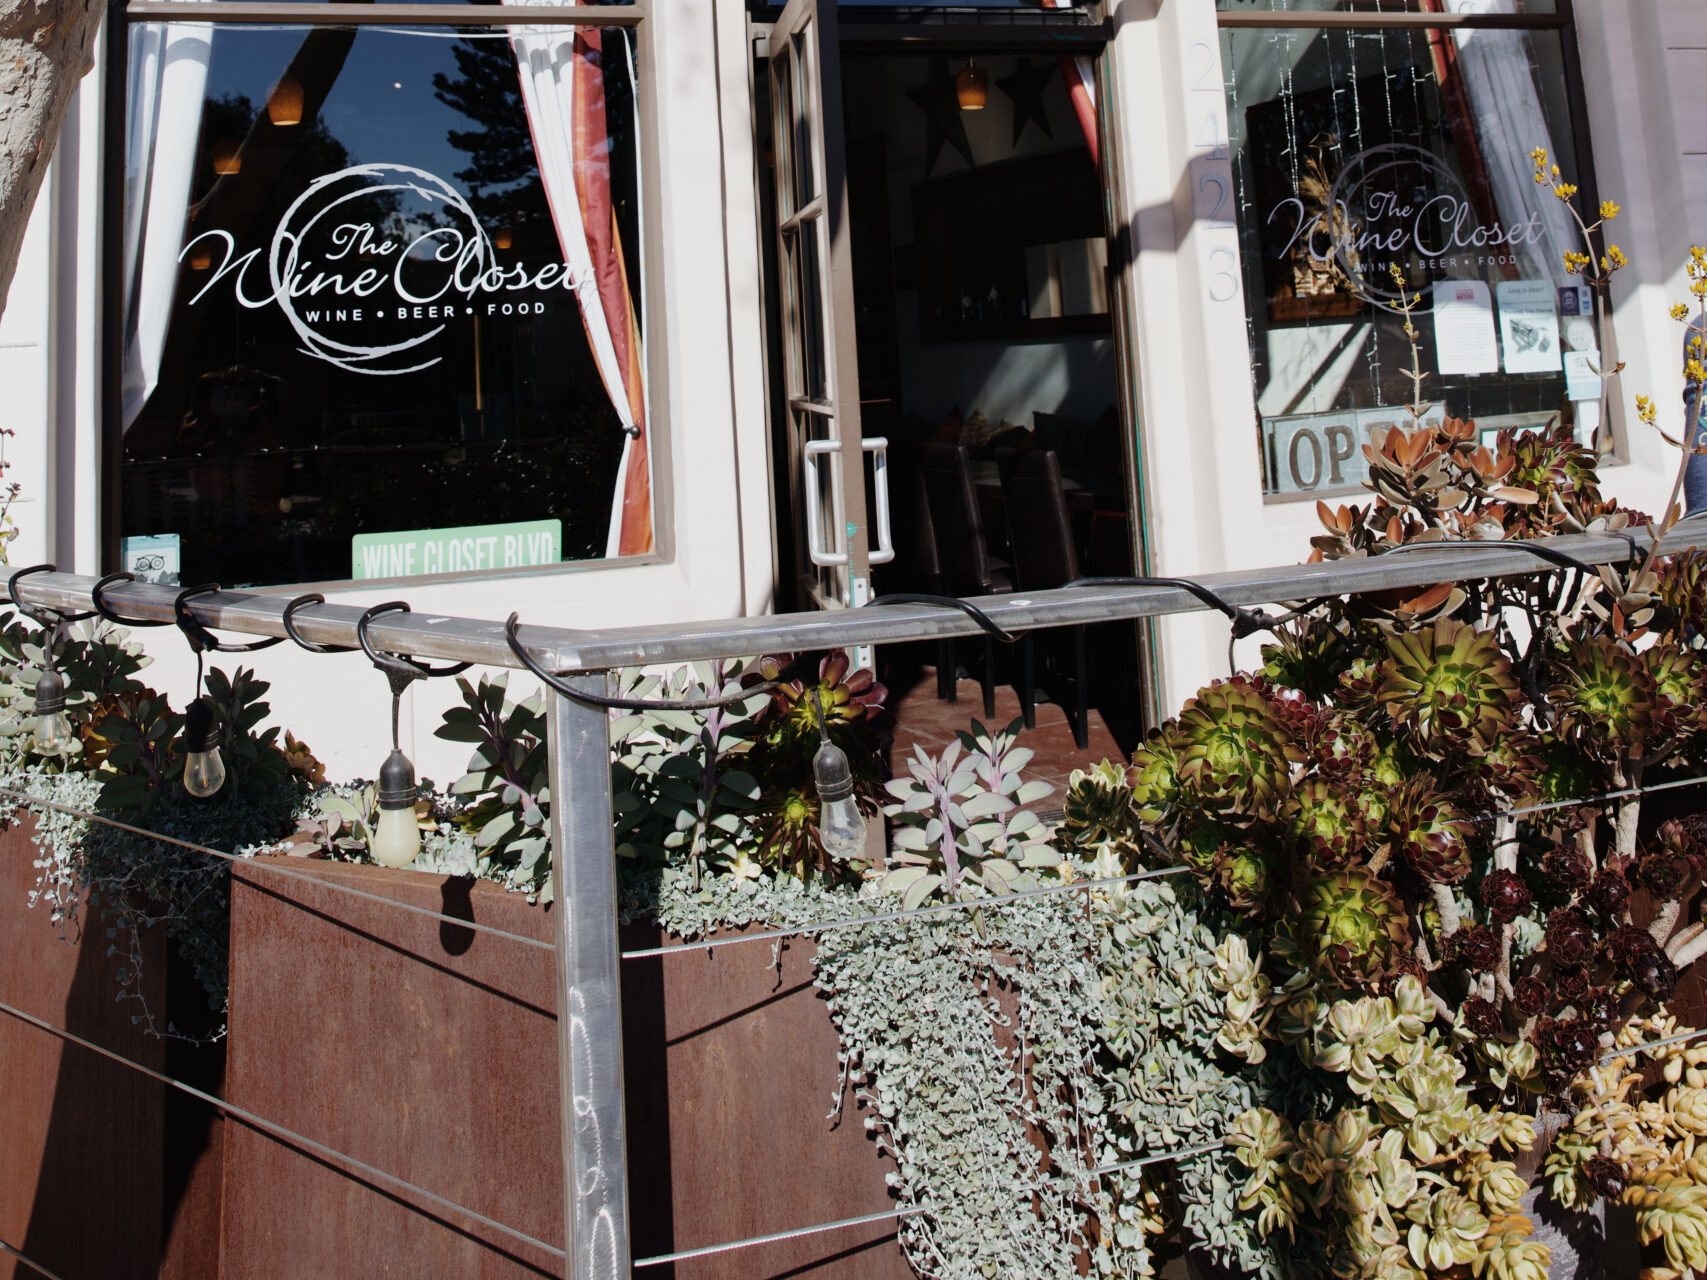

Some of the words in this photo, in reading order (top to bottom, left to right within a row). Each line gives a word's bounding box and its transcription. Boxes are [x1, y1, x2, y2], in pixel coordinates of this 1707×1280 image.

[1366, 191, 1414, 221] The
[325, 223, 398, 260] The
[1267, 197, 1410, 261] Wine
[1414, 194, 1547, 257] Closet
[178, 229, 388, 309] Wine
[393, 228, 595, 304] Closet
[1419, 257, 1458, 269] BEER
[1478, 254, 1518, 266] FOOD
[305, 308, 364, 323] WINE
[397, 305, 456, 320] BEER
[487, 301, 546, 317] FOOD
[362, 541, 417, 580] WINE
[423, 535, 499, 575] CLOSET
